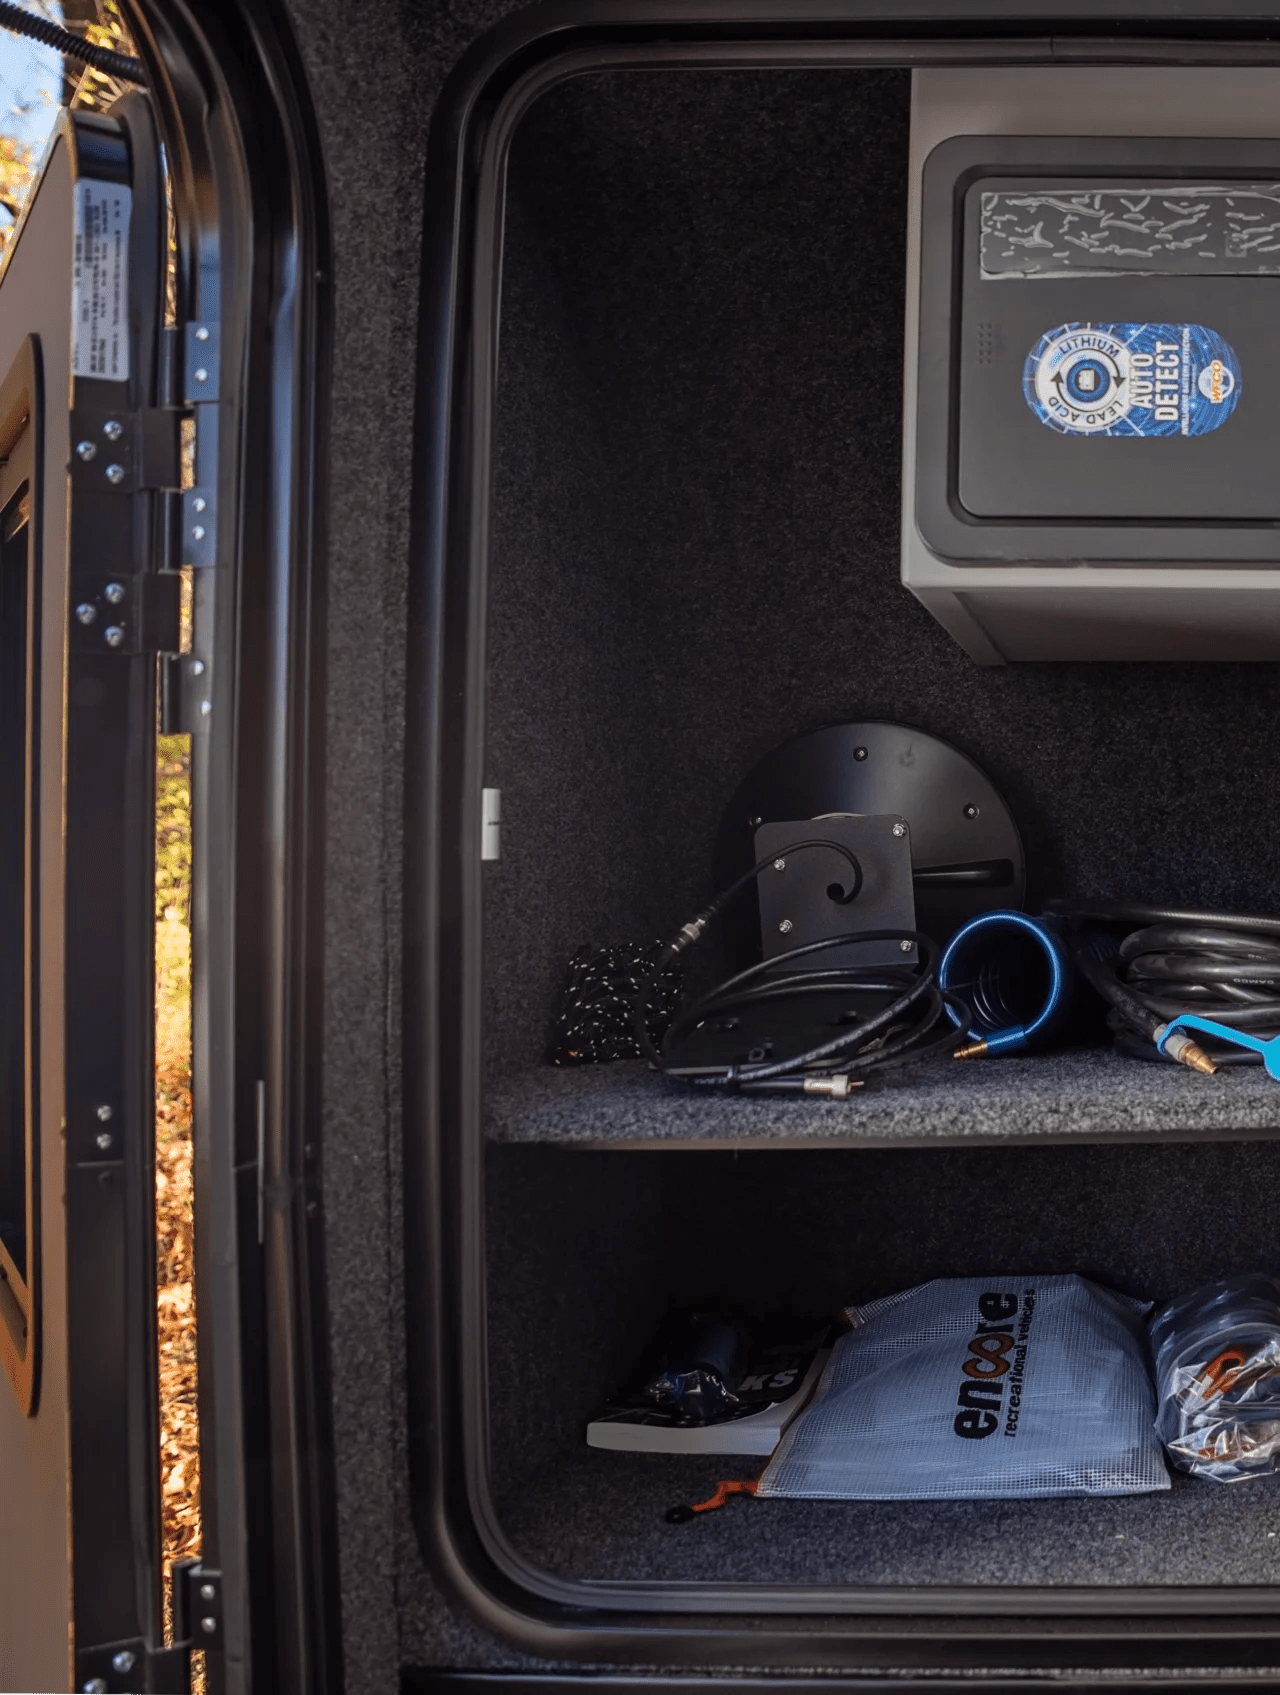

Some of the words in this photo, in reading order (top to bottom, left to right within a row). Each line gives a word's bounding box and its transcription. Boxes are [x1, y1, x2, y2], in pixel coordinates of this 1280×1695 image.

[1059, 336, 1120, 358] LITHIUM
[1129, 353, 1154, 410] AUTO
[1154, 341, 1180, 421] DETECT
[1048, 396, 1080, 423] ACID
[1086, 400, 1123, 424] LEAD
[1004, 1344, 1027, 1437] recreational
